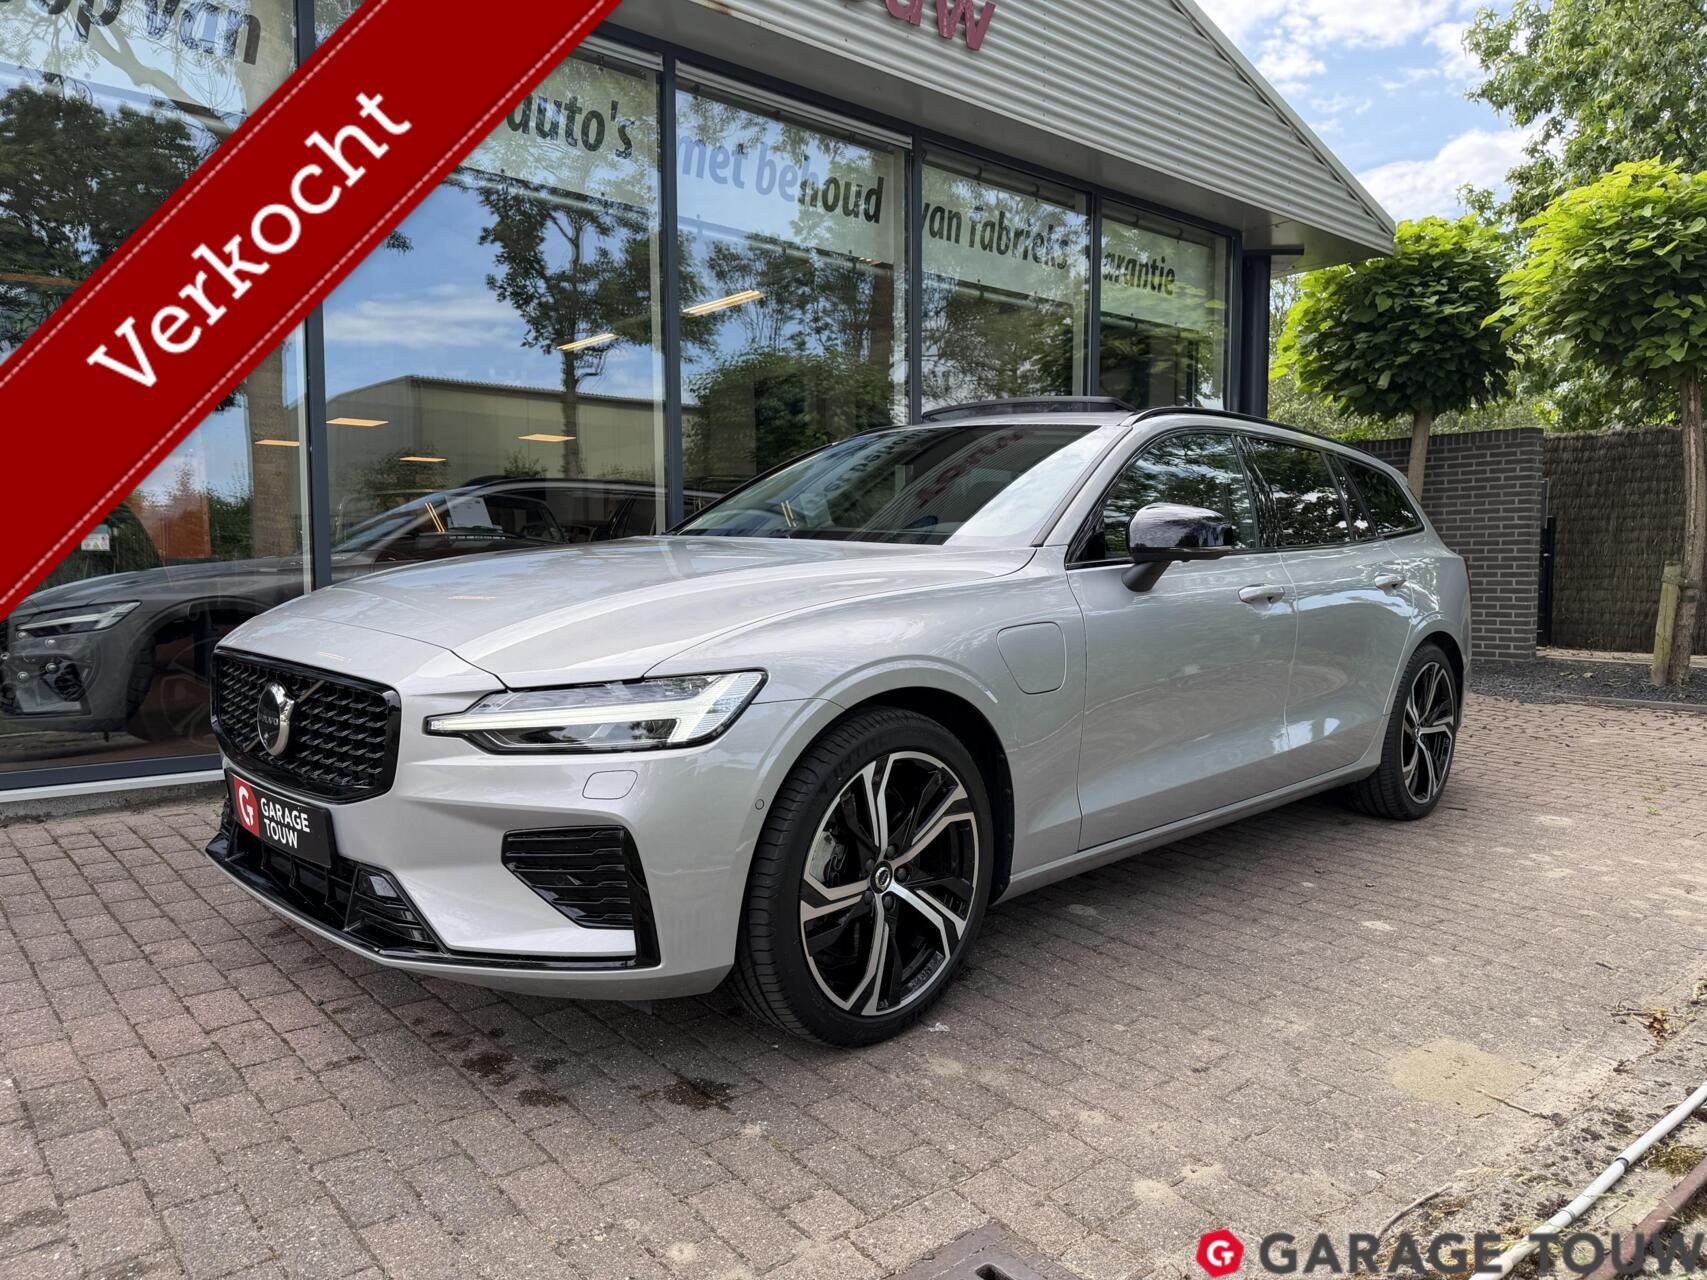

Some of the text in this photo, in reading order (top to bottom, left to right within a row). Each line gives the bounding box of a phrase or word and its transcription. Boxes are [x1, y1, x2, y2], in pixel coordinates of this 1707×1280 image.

[146, 0, 262, 66] van
[506, 93, 636, 160] auto's
[677, 135, 885, 225] met behoud
[1102, 252, 1176, 295] arantie
[239, 786, 254, 826] G
[260, 797, 310, 833] GARAGE
[263, 818, 298, 849] TOUW
